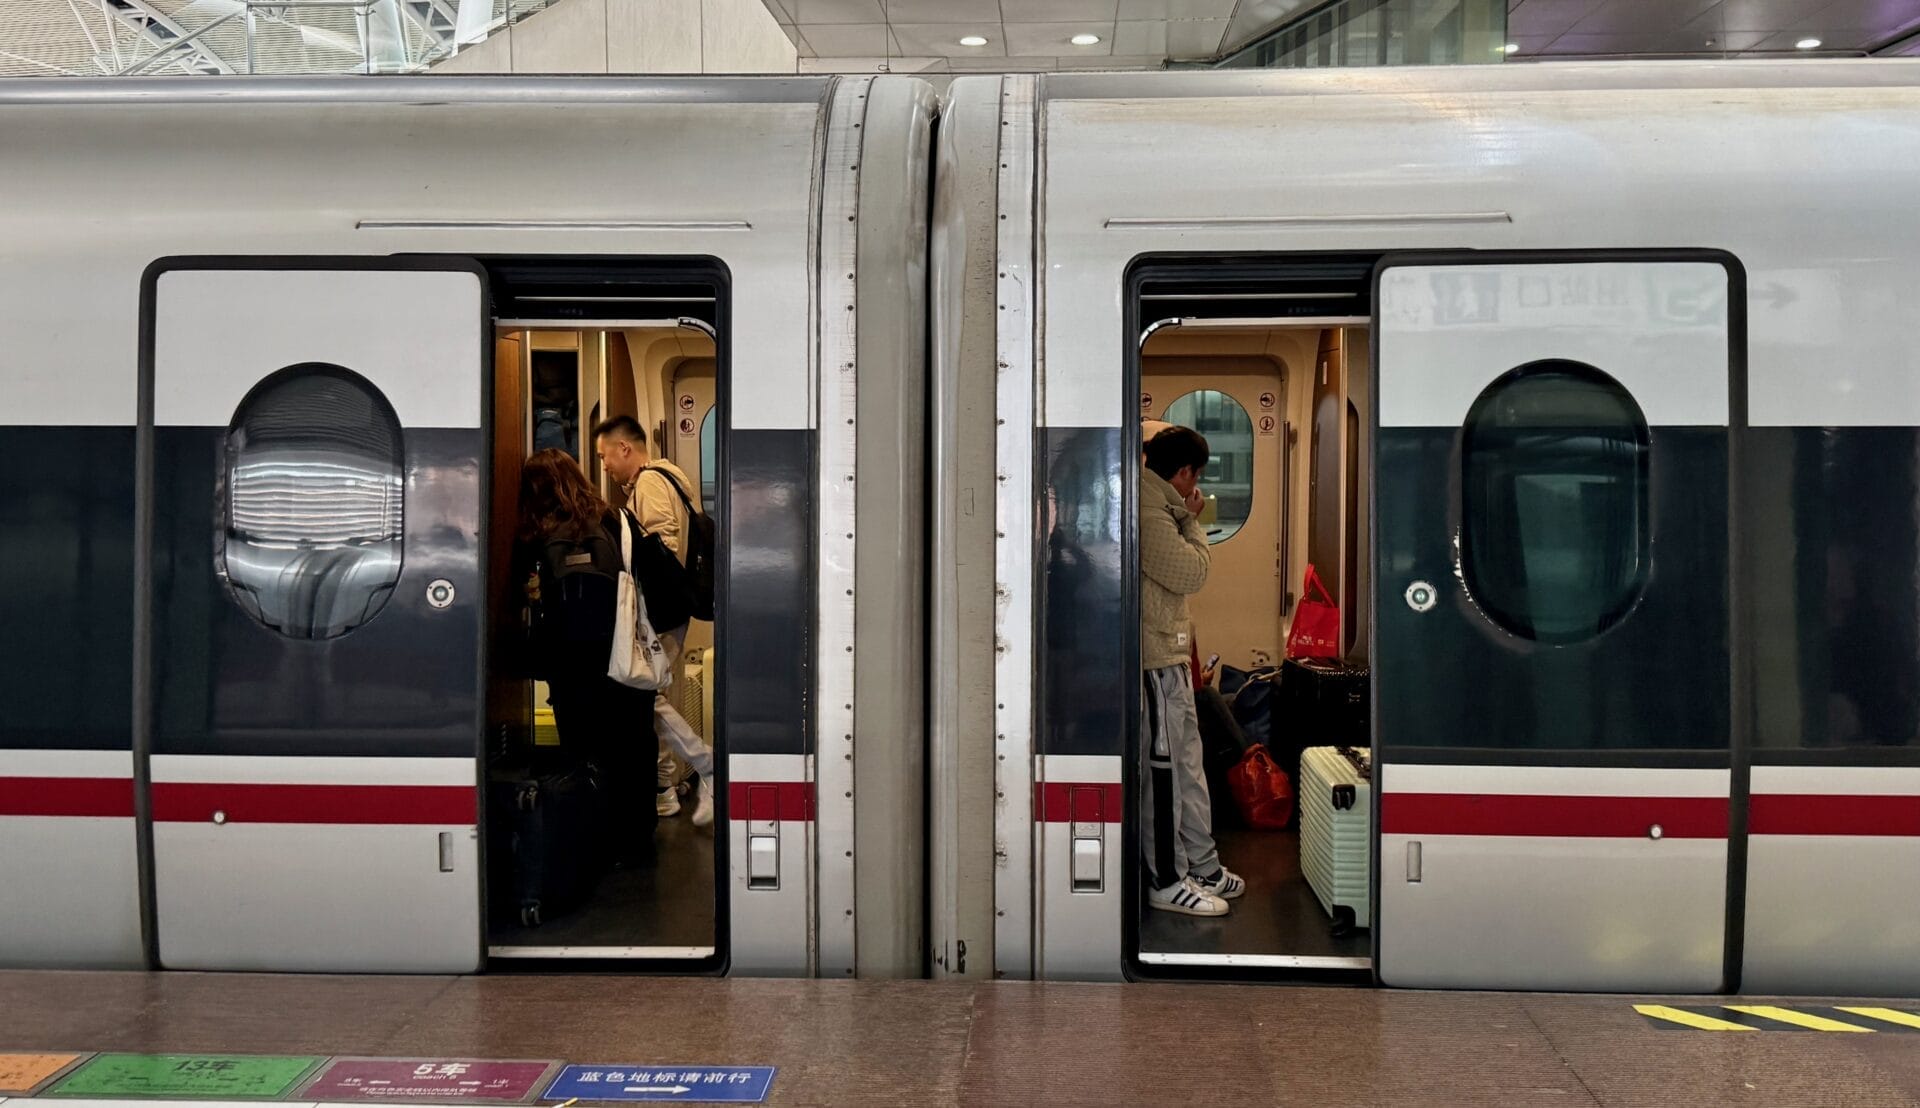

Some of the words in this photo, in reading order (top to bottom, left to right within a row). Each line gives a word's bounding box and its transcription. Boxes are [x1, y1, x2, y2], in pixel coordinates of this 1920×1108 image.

[413, 1063, 471, 1076] 5车
[577, 1071, 752, 1083] 蓝色地标请前行
